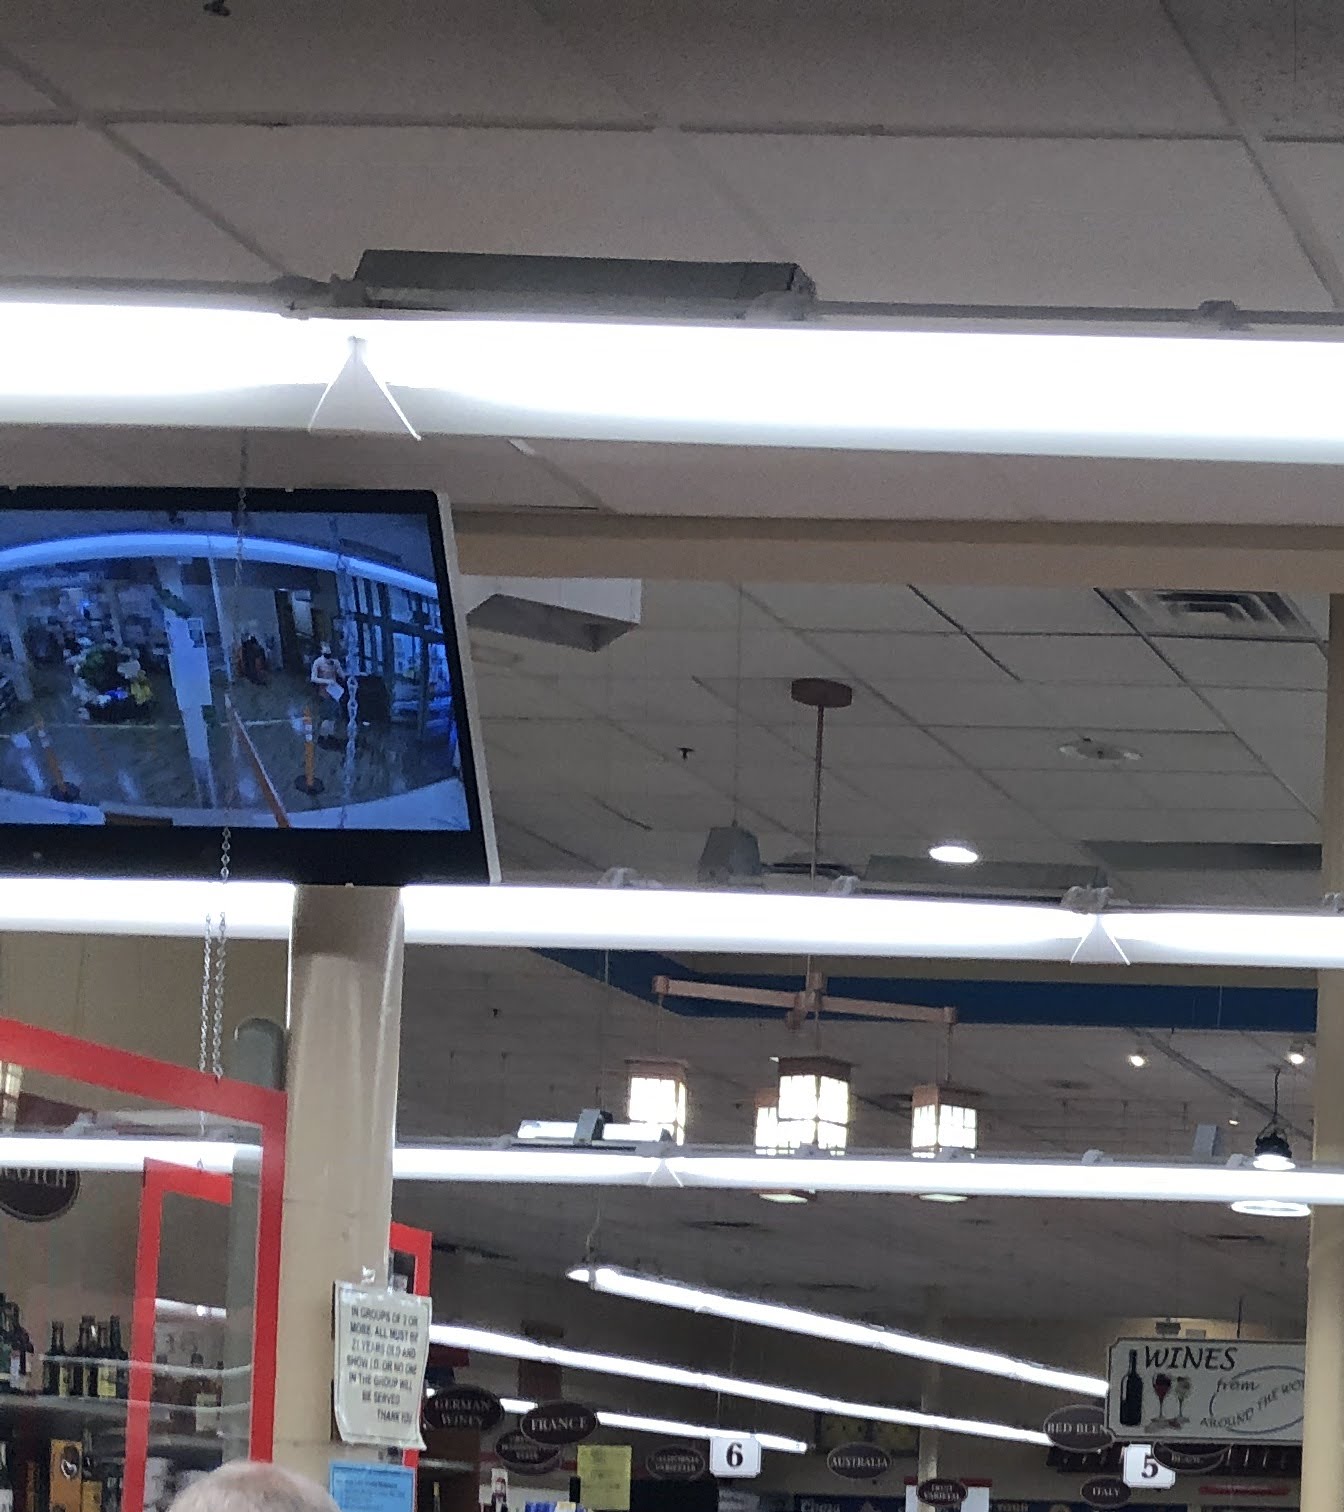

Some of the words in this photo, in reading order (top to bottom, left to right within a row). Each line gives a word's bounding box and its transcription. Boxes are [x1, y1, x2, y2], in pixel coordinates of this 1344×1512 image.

[375, 1326, 387, 1339] ALL
[390, 1330, 408, 1341] MUST
[402, 1347, 416, 1358] AND
[1145, 1346, 1239, 1370] WINES
[347, 1354, 368, 1369] SHOW
[358, 1373, 372, 1385] THE
[374, 1376, 398, 1388] GROUP
[1217, 1377, 1258, 1392] from
[434, 1398, 490, 1411] GERMAN
[1200, 1406, 1254, 1428] AROUND
[1257, 1391, 1279, 1410] THE
[531, 1416, 587, 1432] FRANCE
[1047, 1422, 1073, 1434] RED
[726, 1442, 743, 1468] 6
[831, 1456, 888, 1468] AUSTRALIA
[1141, 1454, 1158, 1478] 5
[1092, 1486, 1120, 1496] ITALY
